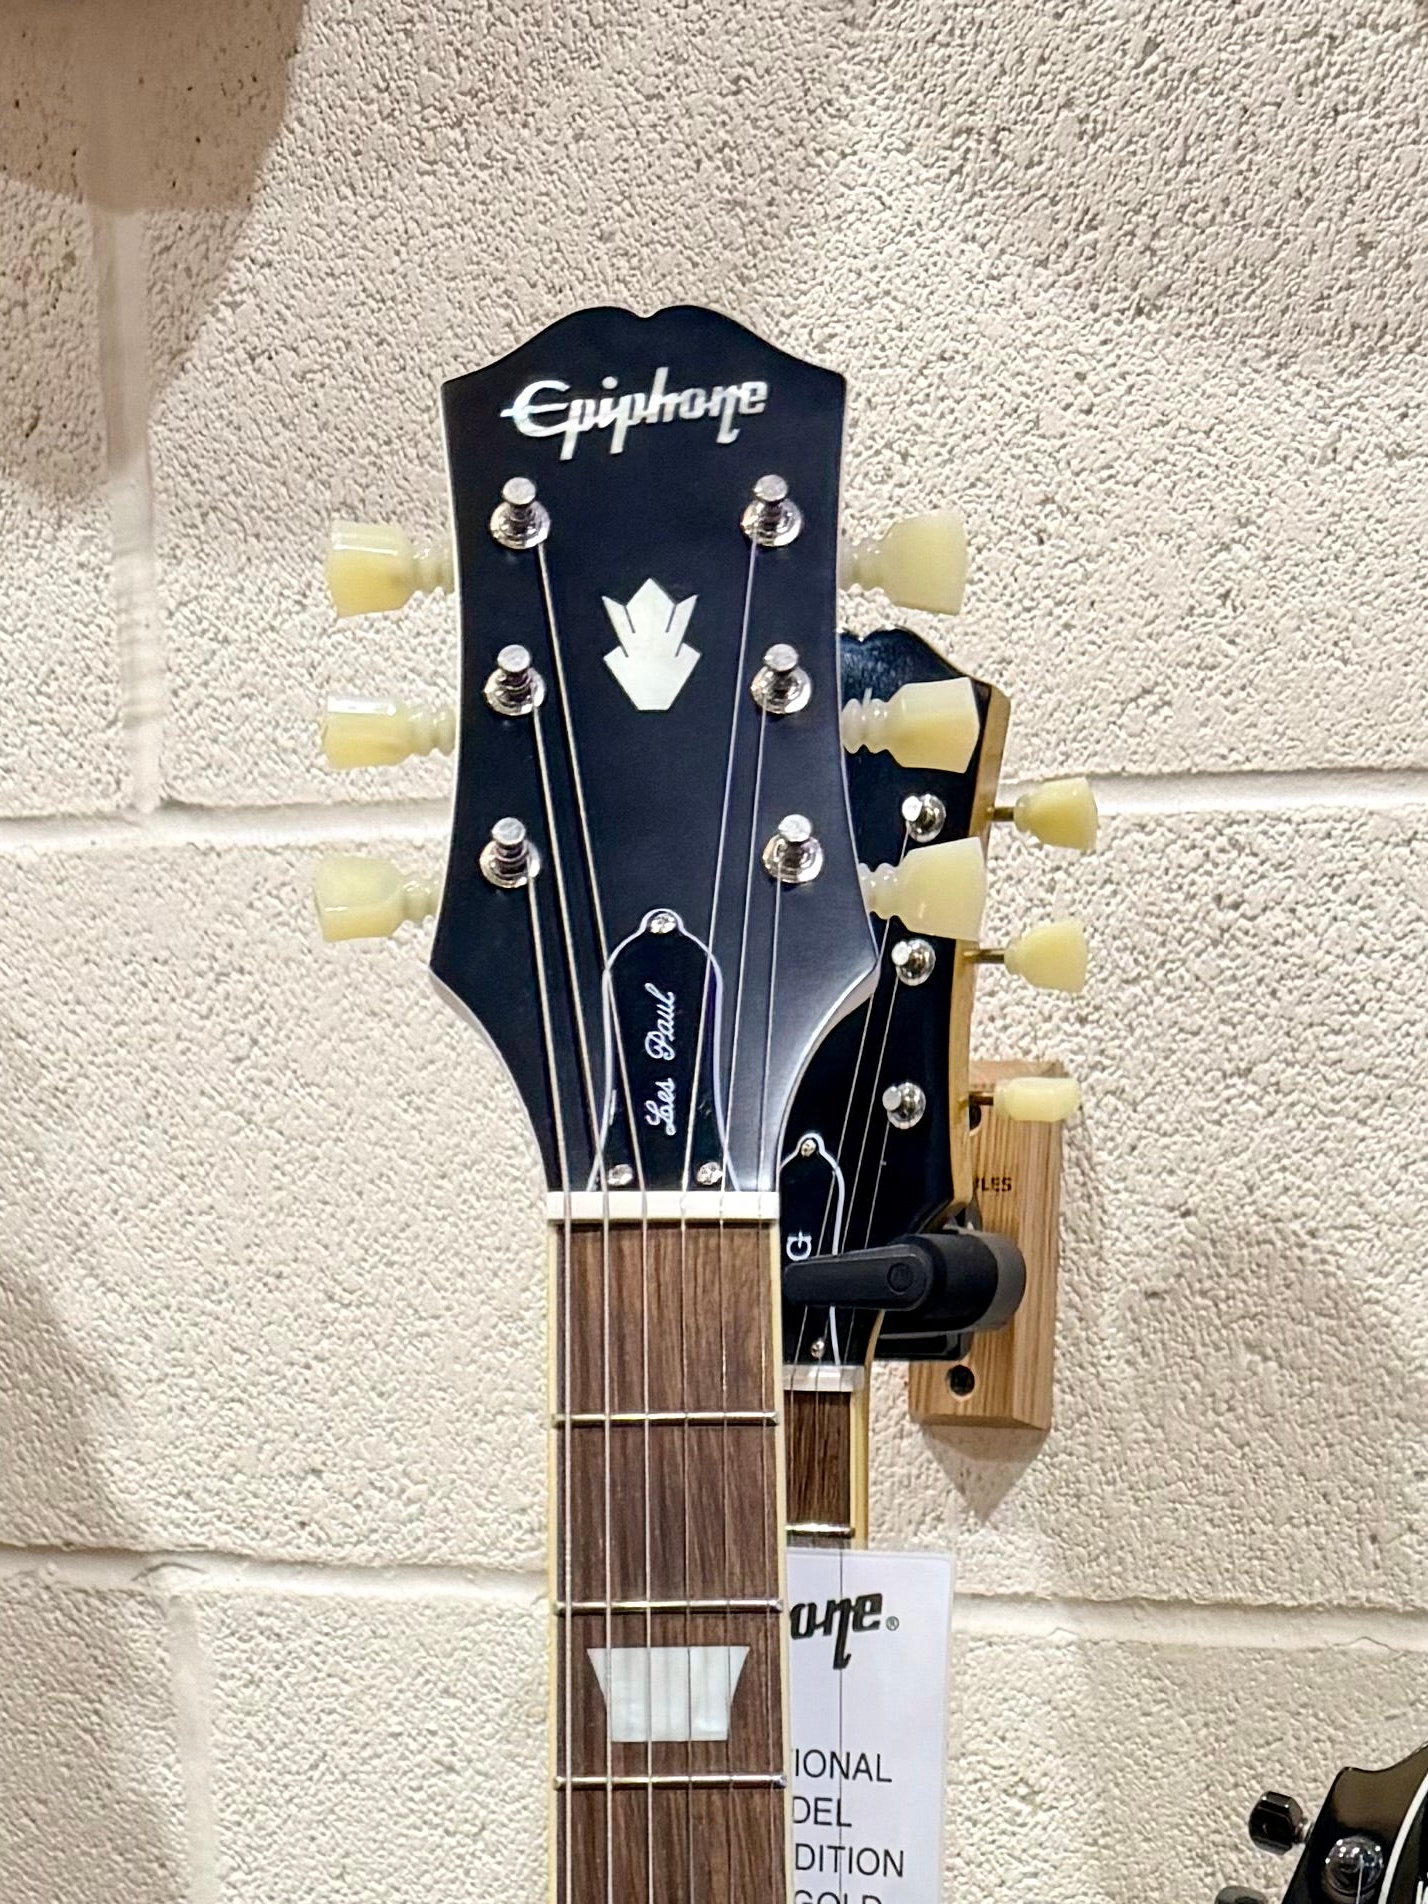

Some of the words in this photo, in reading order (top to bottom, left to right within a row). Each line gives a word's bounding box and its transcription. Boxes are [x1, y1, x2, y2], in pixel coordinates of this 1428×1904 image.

[500, 367, 768, 461] Epiphone
[644, 983, 676, 1061] Paul
[645, 1077, 676, 1136] Les
[795, 1748, 892, 1783] IONAL
[792, 1796, 852, 1827] DEL
[795, 1843, 904, 1878] DITION
